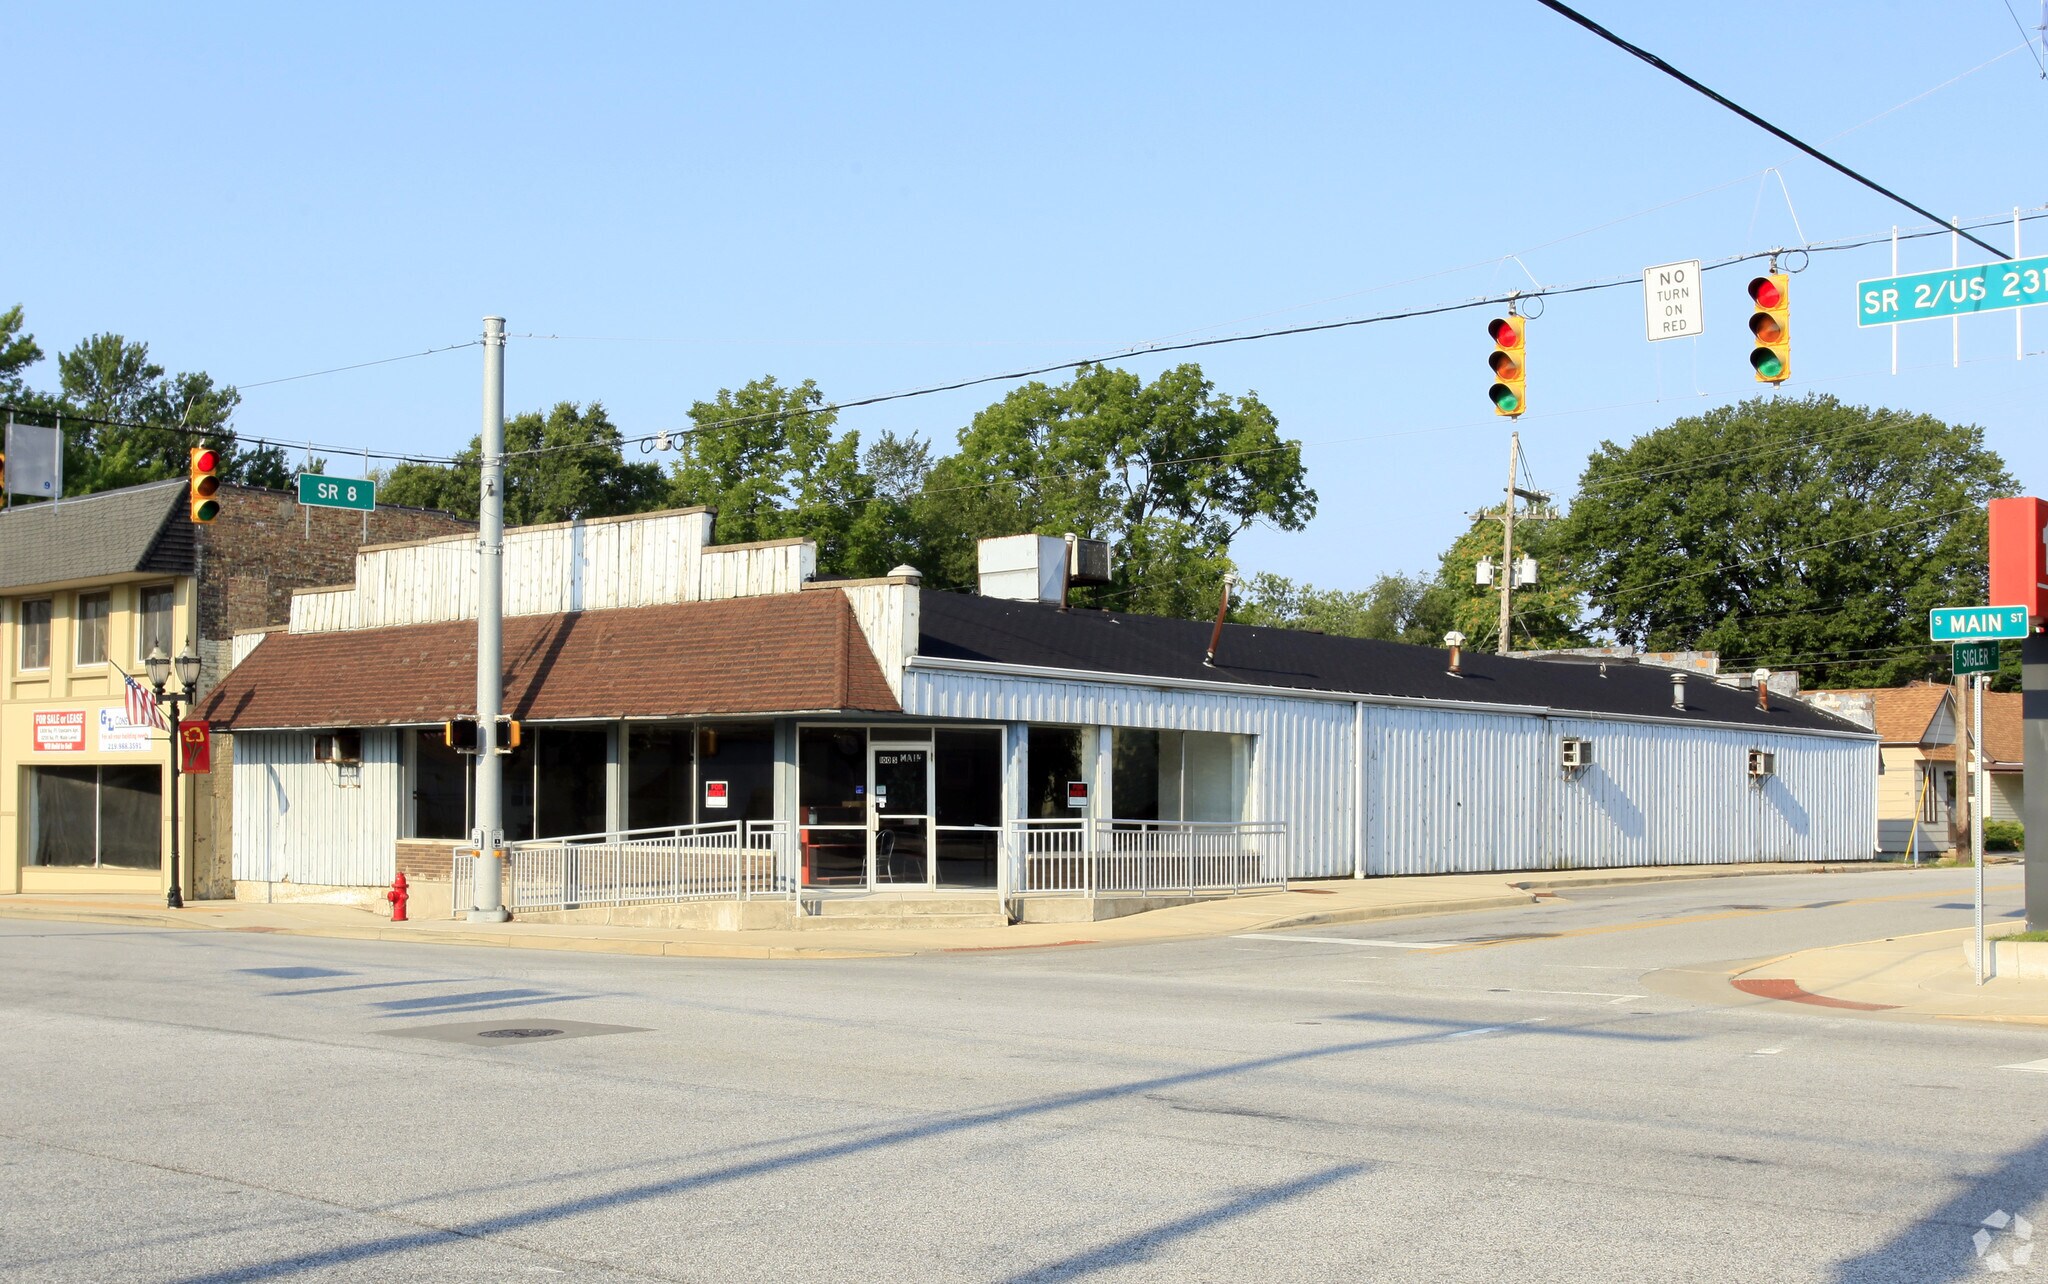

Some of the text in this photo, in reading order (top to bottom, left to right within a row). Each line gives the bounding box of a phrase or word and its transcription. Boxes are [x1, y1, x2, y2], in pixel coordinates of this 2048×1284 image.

[1660, 269, 1685, 286] NO
[1657, 287, 1689, 302] TURN
[1864, 267, 2048, 315] SR 2/US 231
[1665, 303, 1683, 317] ON
[1663, 319, 1687, 333] RED
[318, 482, 357, 502] SR 8
[1934, 613, 2024, 633] S MAIN ST
[1956, 650, 1960, 660] E
[1962, 647, 1989, 668] SIGLER
[35, 713, 46, 725] FOR
[46, 713, 60, 725] SALE
[66, 712, 83, 724] LEASE
